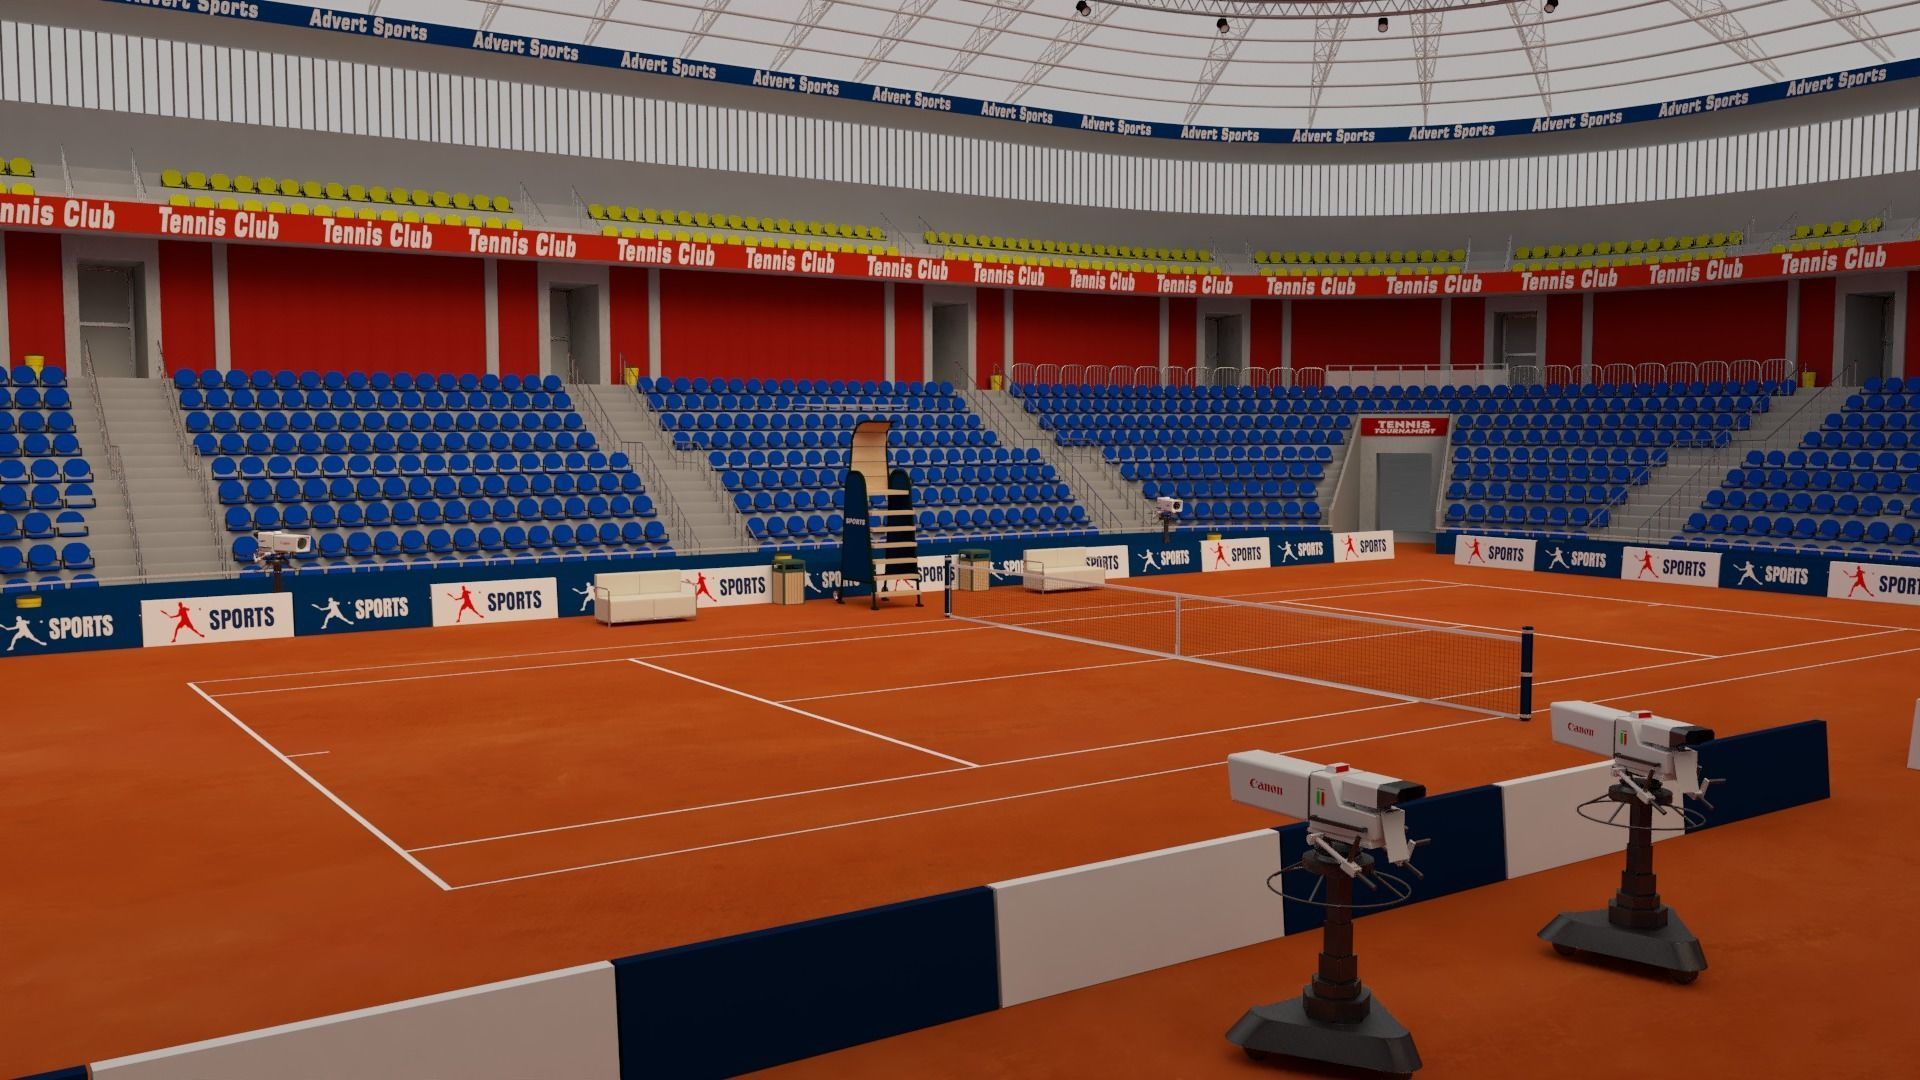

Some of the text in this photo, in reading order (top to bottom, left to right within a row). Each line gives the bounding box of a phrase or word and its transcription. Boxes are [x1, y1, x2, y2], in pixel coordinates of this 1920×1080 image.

[197, 0, 258, 18] Sports
[310, 9, 428, 41] Advert Sports
[473, 31, 579, 61] Advert Sports
[621, 52, 716, 79] Advert Sports
[753, 70, 839, 96] Advert Sports
[1787, 67, 1887, 96] Advert Sports
[872, 86, 951, 111] Advert Sports
[1659, 92, 1749, 117] Advert Sports
[981, 101, 1053, 124] Advert Sports
[1532, 111, 1623, 132] Advert Sports
[1081, 115, 1152, 136] Advert Sports
[1181, 126, 1260, 142] Advert Sports
[1292, 128, 1375, 143] Advert Sports
[1408, 125, 1495, 140] Advert Sports
[64, 200, 115, 230] Club
[159, 206, 280, 240] Tennis Club
[322, 218, 433, 250] Tennis Club
[468, 228, 577, 259] Tennis Club
[617, 238, 716, 267] Tennis Club
[746, 247, 835, 274] Tennis Club
[1781, 245, 1888, 275] Tennis Club
[867, 255, 949, 281] Tennis Club
[973, 262, 1045, 287] Tennis Club
[1521, 267, 1619, 291] Tennis Club
[1649, 257, 1744, 285] Tennis Club
[1069, 268, 1136, 292] Tennis Club
[1157, 273, 1234, 295] Tennis Club
[1266, 276, 1357, 296] Tennis Club
[1386, 274, 1483, 295] Tennis Club
[1378, 420, 1431, 429] TENNIS
[1231, 546, 1262, 562] SPORTS
[1297, 541, 1324, 557] SPORTS
[1360, 538, 1387, 553] SPORTS
[1487, 545, 1524, 563] SPORTS
[1161, 549, 1190, 566] SPORTS
[1571, 550, 1607, 568] SPORTS
[1662, 558, 1707, 578] SPORTS
[720, 576, 766, 596] SPORTS
[1765, 565, 1809, 585] SPORTS
[1879, 575, 1920, 595] SPOR
[355, 597, 409, 619] SPORTS
[487, 590, 542, 612] SPORTS
[49, 614, 114, 640] SPORTS
[209, 606, 275, 630] SPORTS
[1568, 722, 1594, 737] Canon
[1250, 778, 1283, 796] Canon
